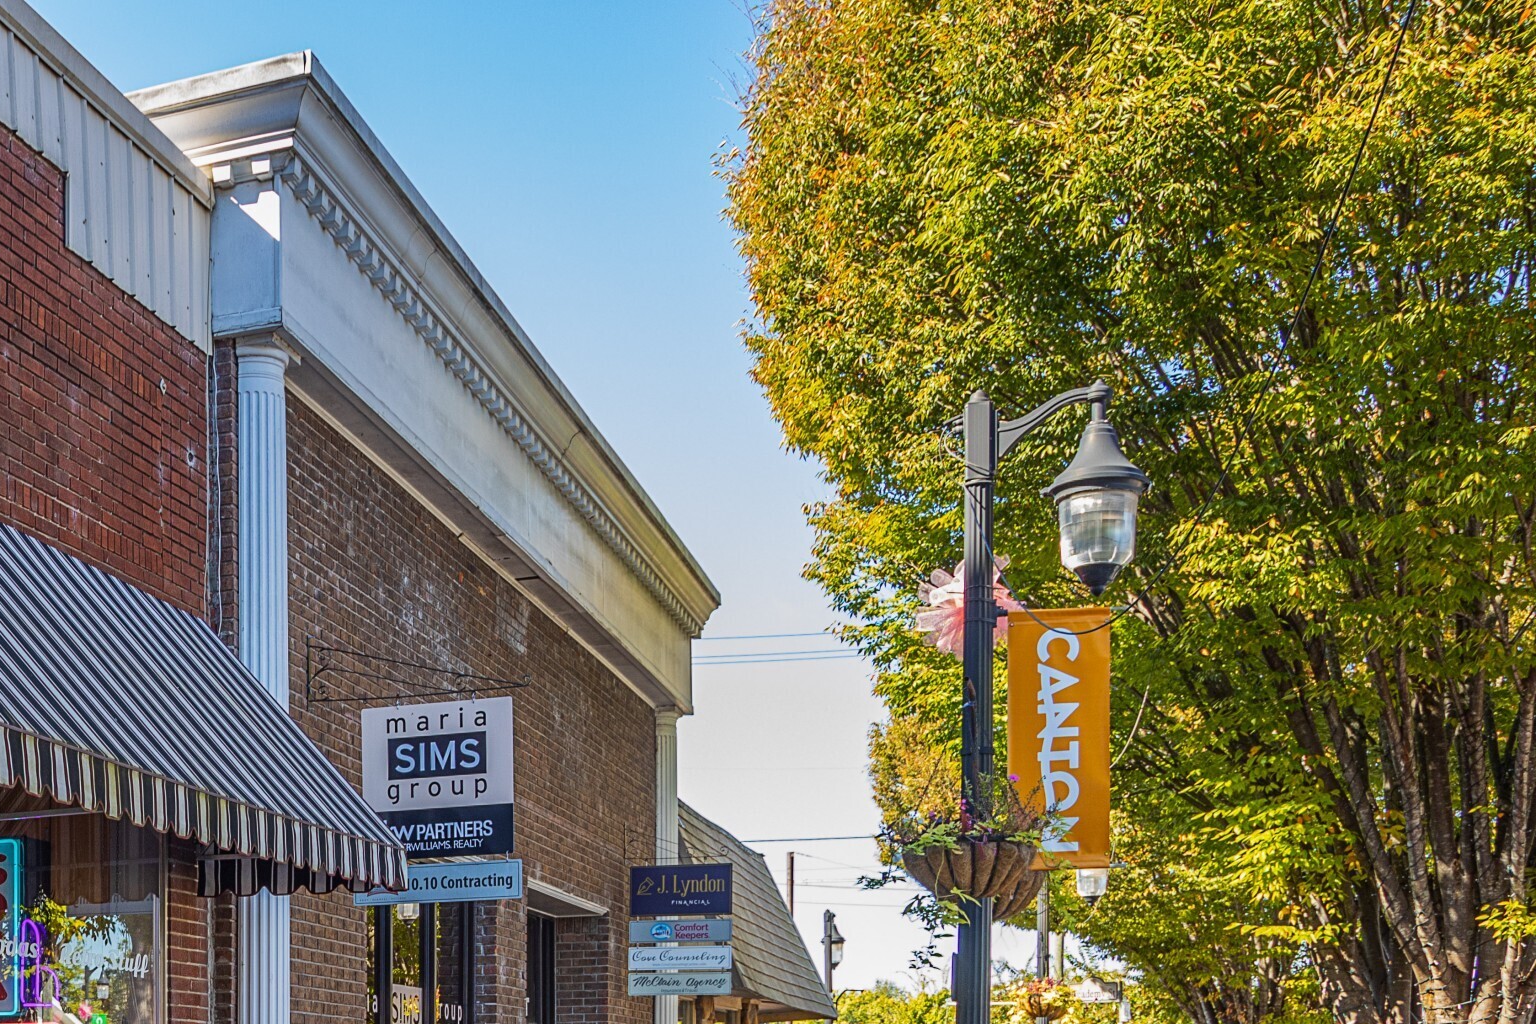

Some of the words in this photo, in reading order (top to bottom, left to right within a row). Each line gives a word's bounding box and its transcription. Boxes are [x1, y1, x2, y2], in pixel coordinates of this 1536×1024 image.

[386, 707, 487, 734] maria
[1036, 627, 1080, 853] CANTON
[395, 738, 480, 773] SIMS
[388, 777, 487, 804] group
[416, 820, 493, 841] PARTNERS
[453, 838, 483, 848] REALTY
[440, 873, 513, 890] Contracting
[657, 875, 669, 894] J.
[673, 873, 726, 897] Lyndon
[674, 923, 709, 932] Comfort
[675, 931, 709, 940] Keepers
[659, 950, 727, 964] Counseling
[633, 976, 681, 987] McClain
[686, 977, 727, 988] Agency
[392, 992, 420, 1024] SIMS
[438, 1002, 463, 1024] roup
